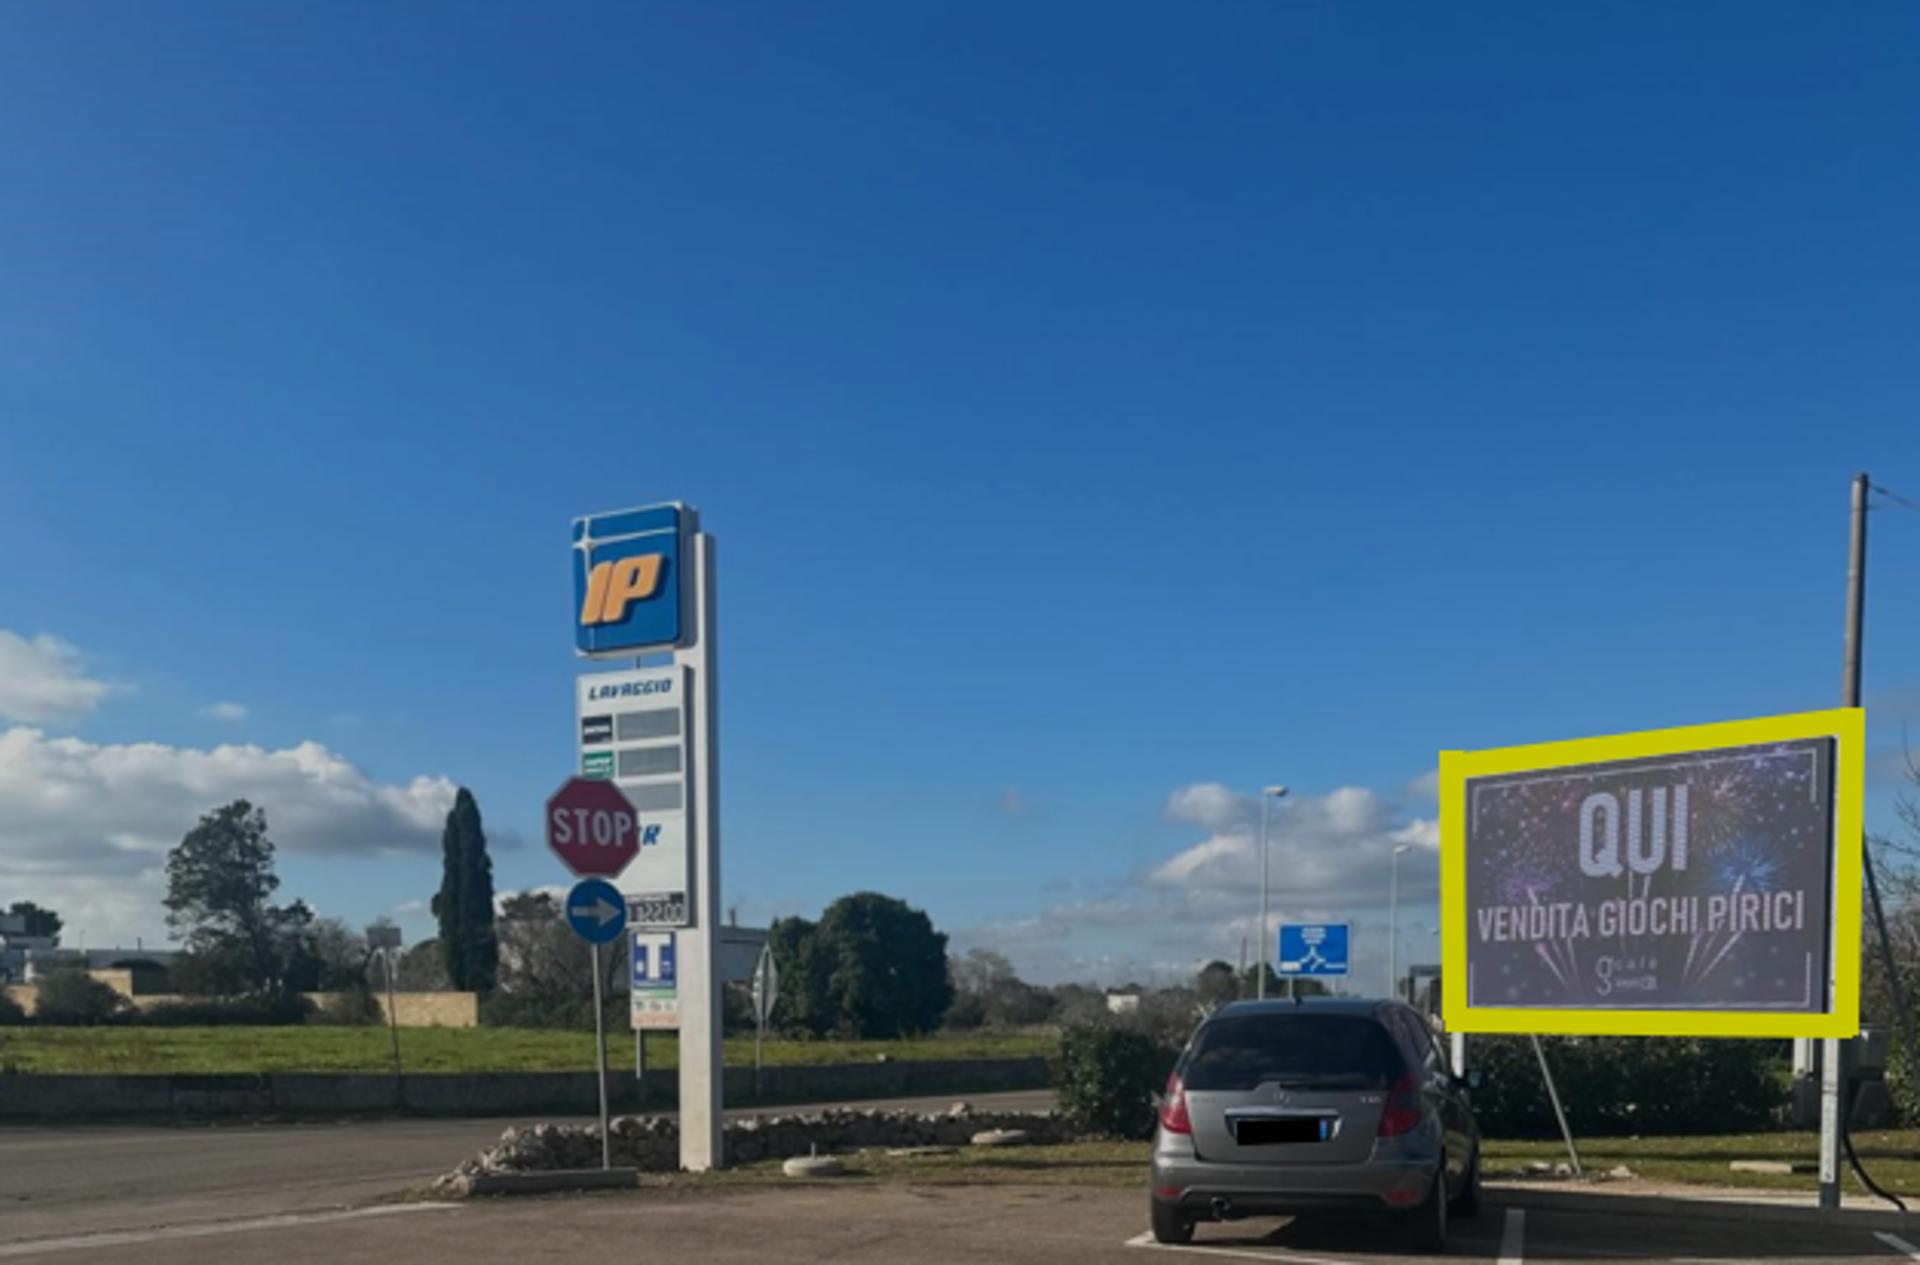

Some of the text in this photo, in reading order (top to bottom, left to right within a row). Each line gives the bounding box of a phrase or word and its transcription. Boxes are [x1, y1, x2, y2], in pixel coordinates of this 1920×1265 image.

[581, 553, 662, 624] IP
[553, 807, 632, 847] STOP
[1578, 784, 1688, 878] QUI
[1477, 890, 1804, 942] VENDITA GIOCHI PIRICI
